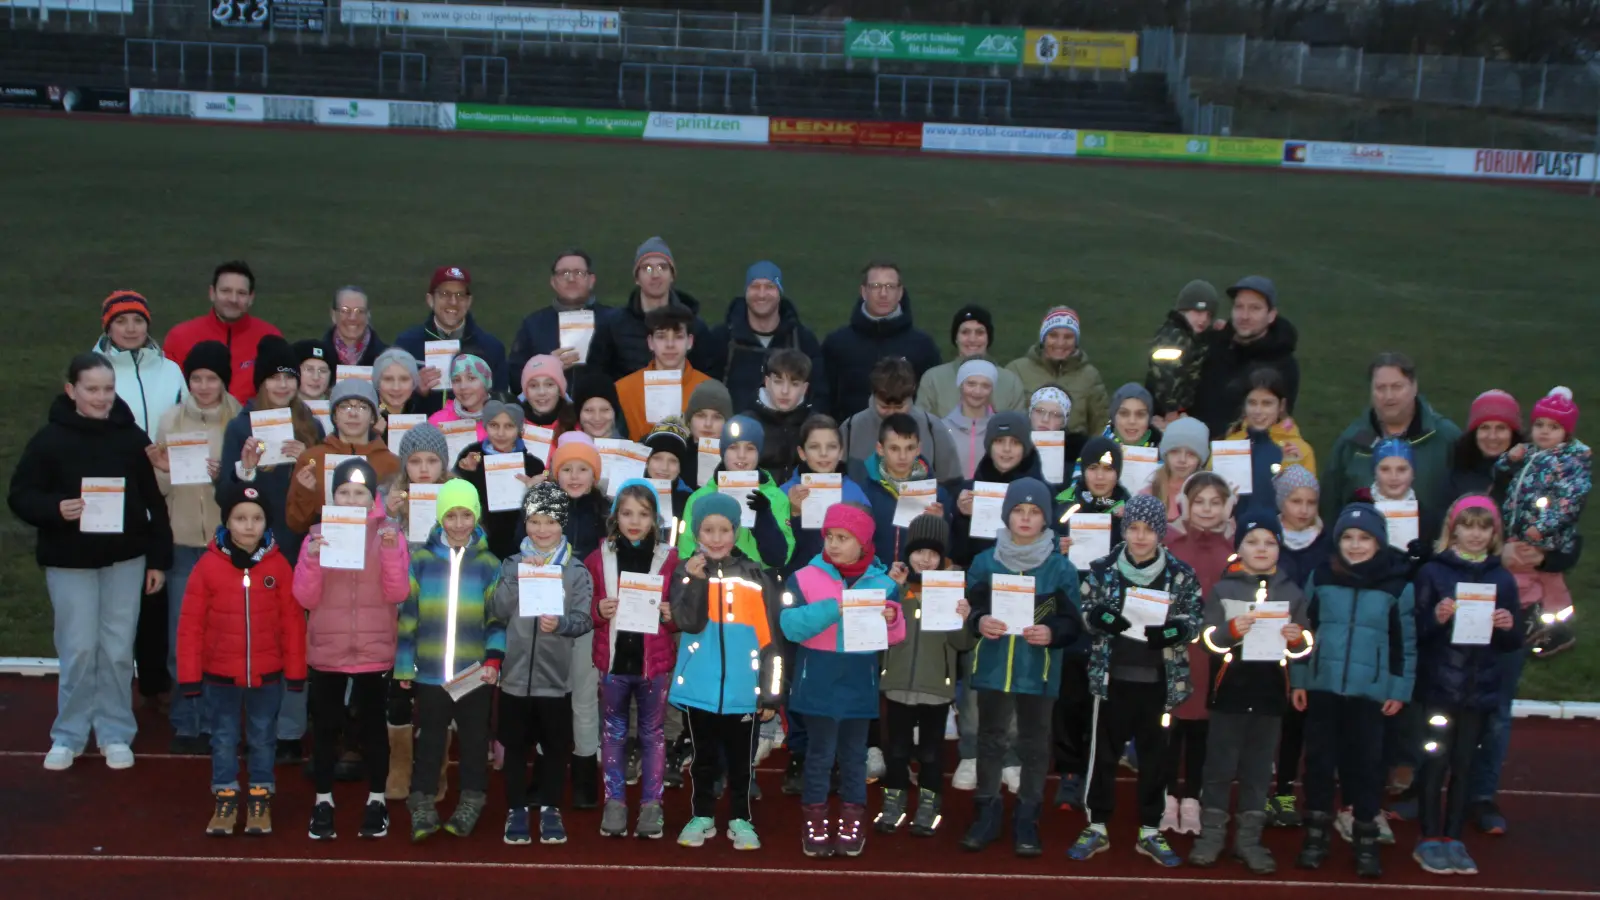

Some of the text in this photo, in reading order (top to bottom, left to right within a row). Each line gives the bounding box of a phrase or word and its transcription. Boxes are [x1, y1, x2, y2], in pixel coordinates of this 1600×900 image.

[852, 29, 895, 46] AOK
[900, 31, 927, 43] Sport
[977, 34, 1018, 51] AOK
[908, 43, 920, 54] fit
[458, 111, 643, 128] Nordbayerns leistungsstarkes Druckzentrum
[925, 127, 1075, 141] www.strobl-container.de
